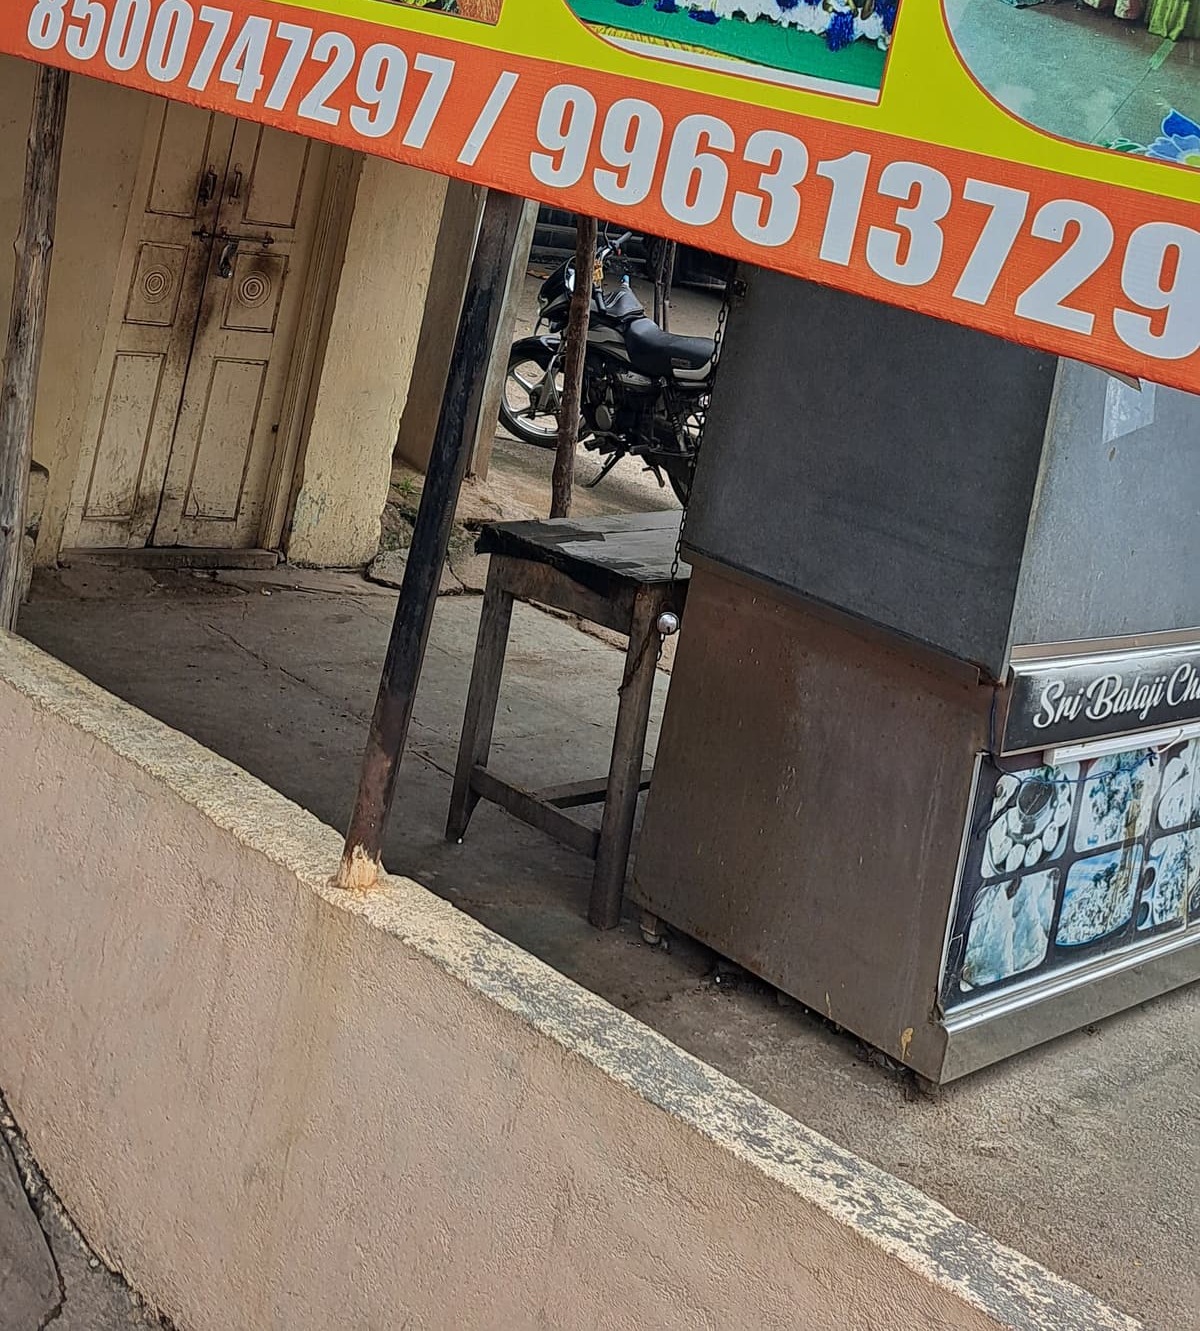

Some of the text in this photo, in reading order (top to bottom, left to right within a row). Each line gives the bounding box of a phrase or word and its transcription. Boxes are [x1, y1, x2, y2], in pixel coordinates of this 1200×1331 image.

[529, 84, 1200, 360] 996313729
[1033, 663, 1200, 728] Sri Balaji Ch
